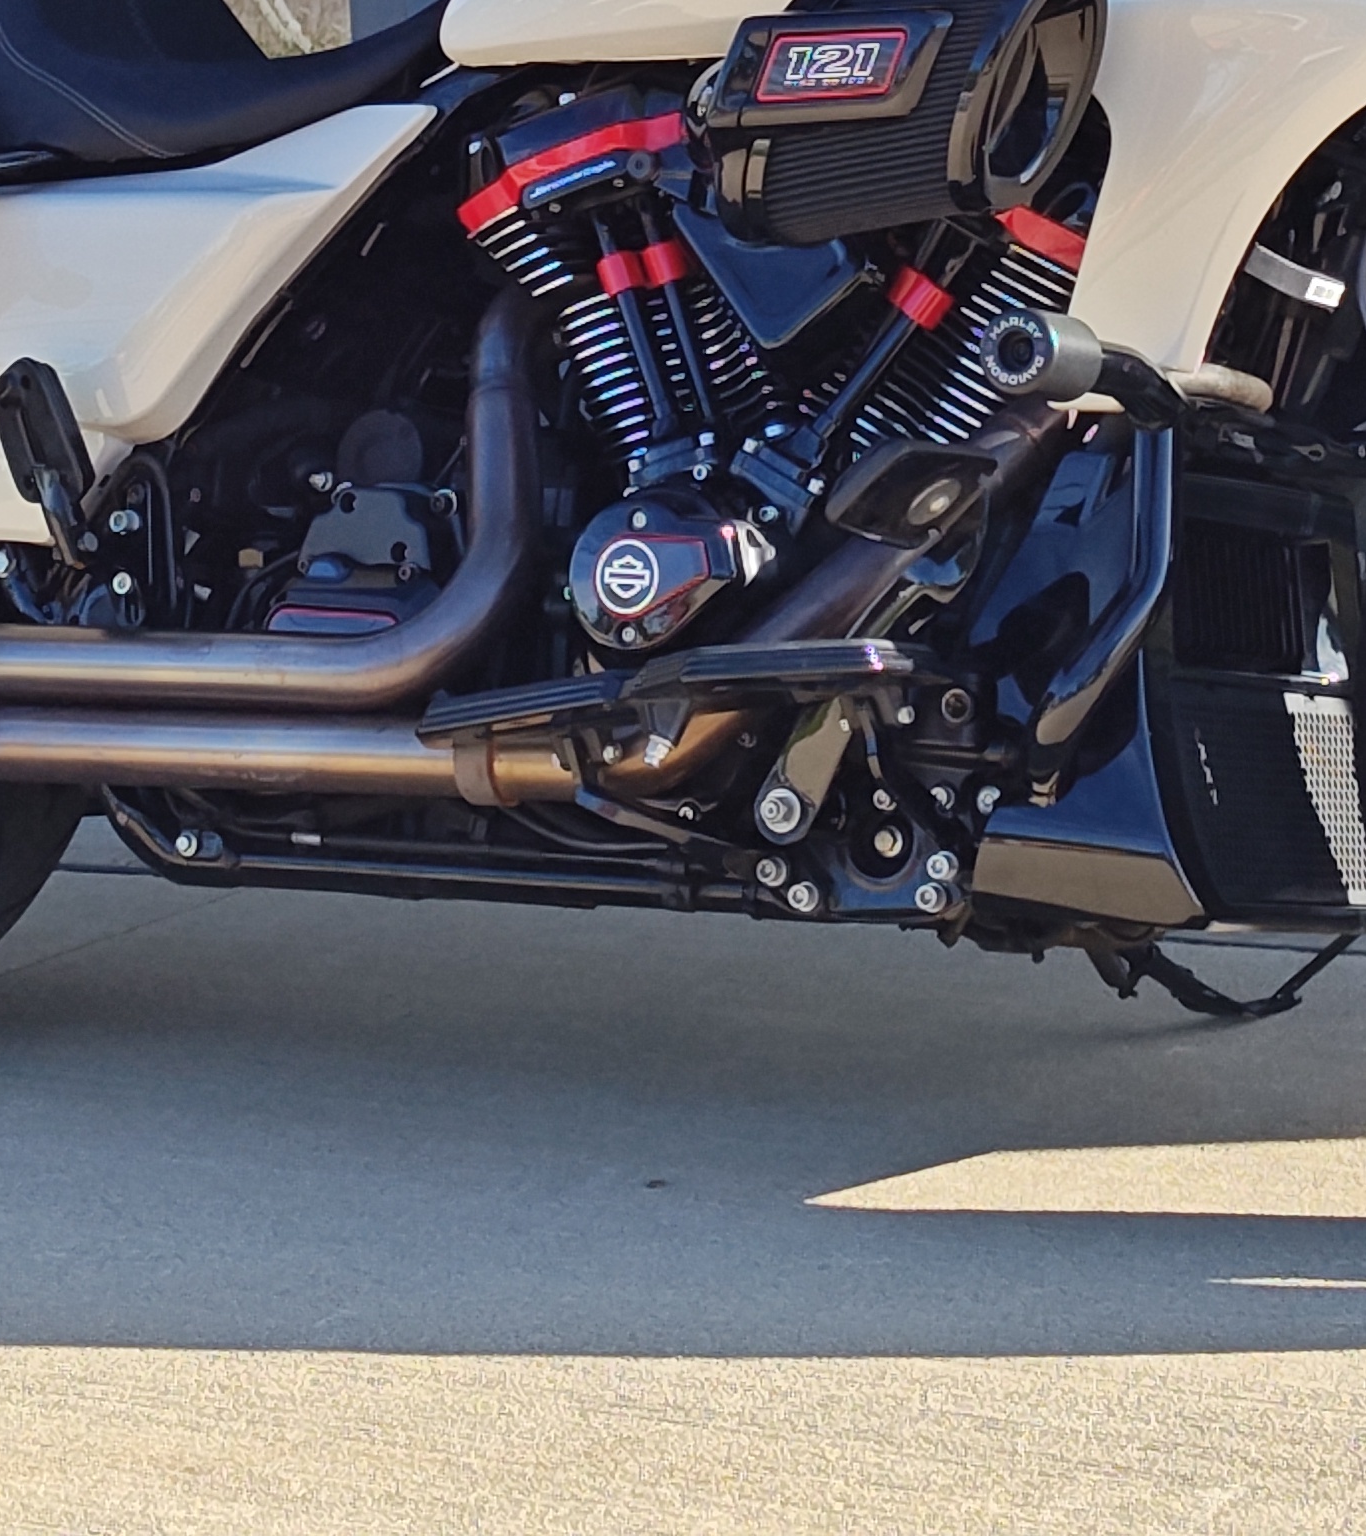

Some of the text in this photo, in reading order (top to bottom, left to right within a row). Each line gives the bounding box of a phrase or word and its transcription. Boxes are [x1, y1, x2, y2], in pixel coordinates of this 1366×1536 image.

[785, 42, 881, 81] 121
[988, 315, 1044, 341] HARLEY
[984, 354, 1046, 387] DAVIDSON
